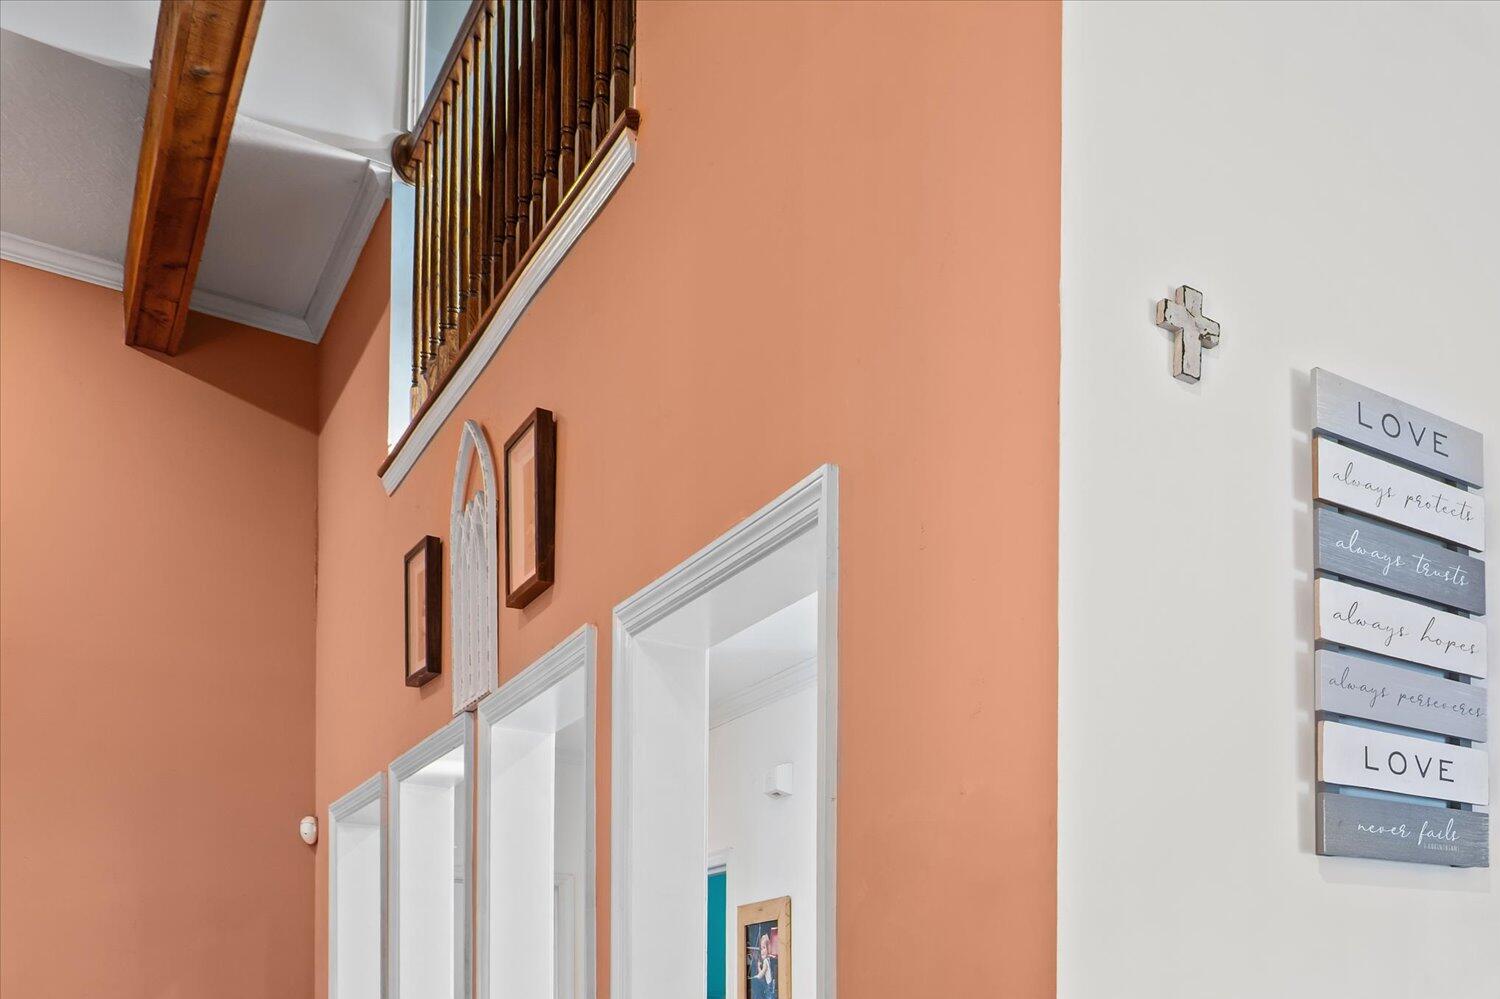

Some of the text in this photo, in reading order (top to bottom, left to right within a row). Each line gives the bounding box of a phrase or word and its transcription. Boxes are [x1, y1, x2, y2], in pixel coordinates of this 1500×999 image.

[1358, 401, 1449, 457] LOVE
[1331, 462, 1474, 522] always protects
[1335, 529, 1470, 586] always trusts
[1332, 601, 1479, 654] always hopes
[1328, 666, 1487, 718] always perseveres
[1364, 745, 1455, 783] LOVE
[1357, 822, 1411, 839] never
[1417, 817, 1461, 847] fails
